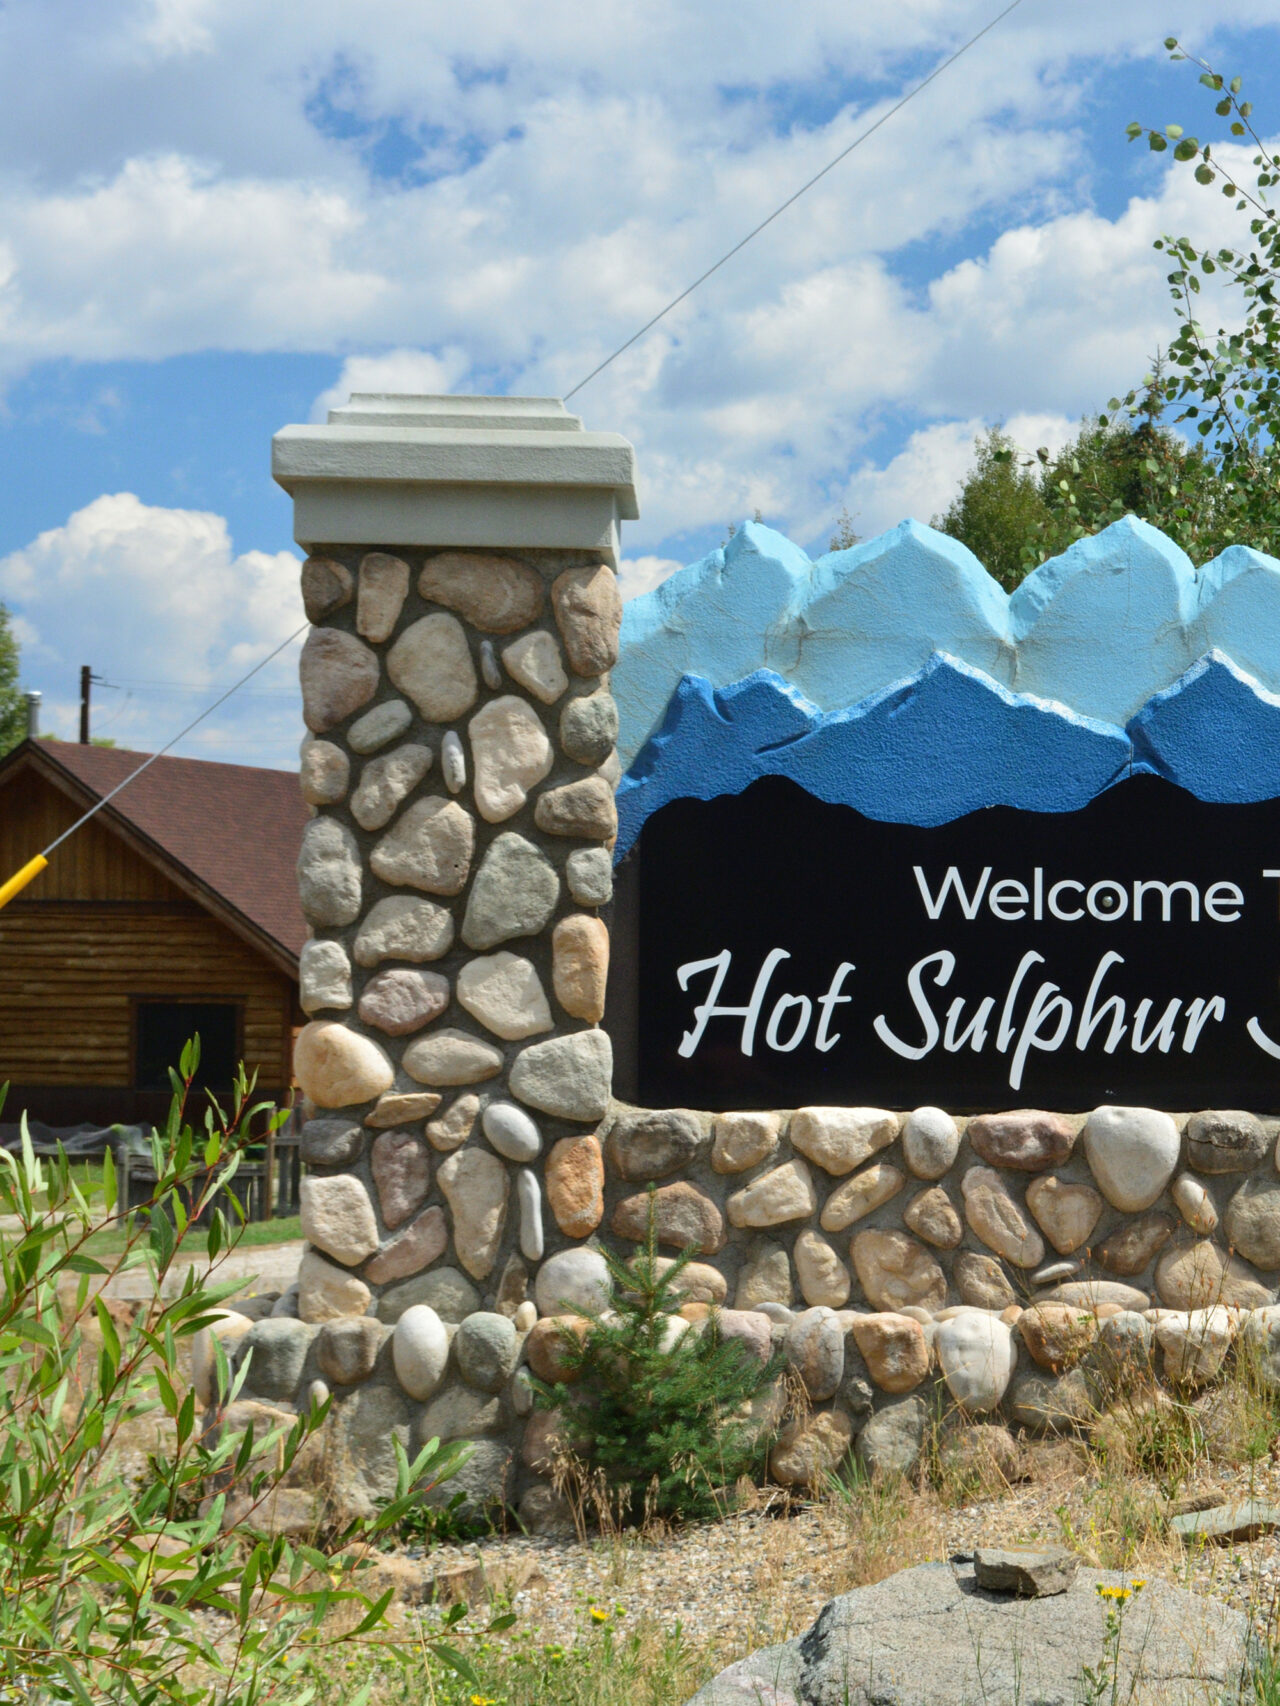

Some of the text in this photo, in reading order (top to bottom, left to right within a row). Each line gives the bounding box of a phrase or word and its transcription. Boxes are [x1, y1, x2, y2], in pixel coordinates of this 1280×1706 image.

[912, 865, 1245, 922] Welcome
[676, 947, 856, 1058] Hot
[872, 949, 1226, 1091] Sulphur
